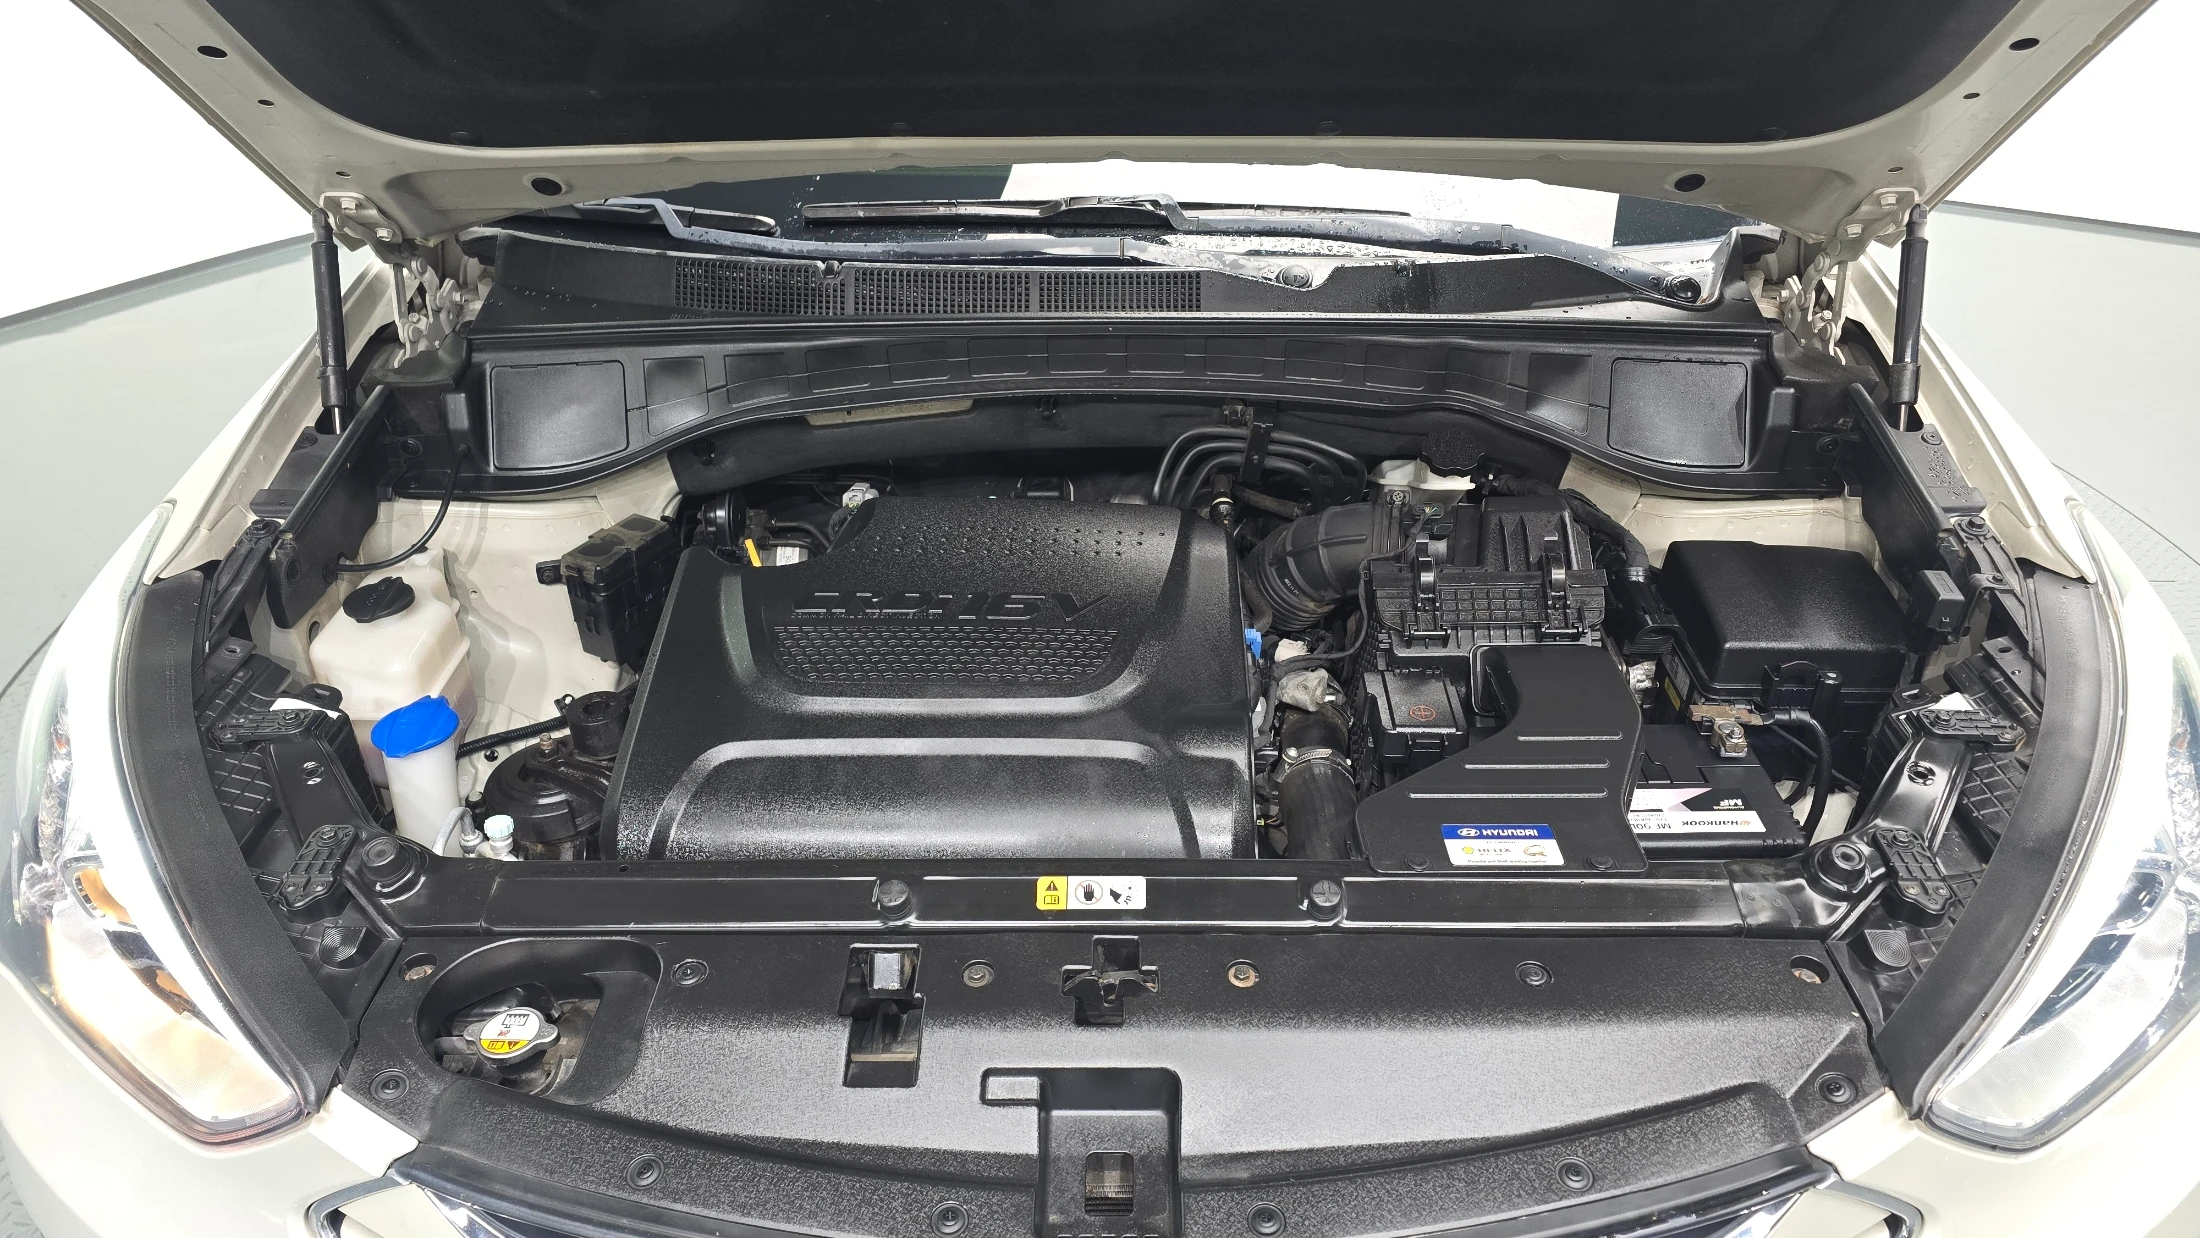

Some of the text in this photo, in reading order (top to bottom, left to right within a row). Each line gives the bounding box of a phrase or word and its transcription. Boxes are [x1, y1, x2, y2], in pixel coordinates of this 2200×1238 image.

[957, 591, 1113, 622] 16V
[1719, 798, 1742, 806] MF
[1482, 828, 1539, 837] HYUNDAI
